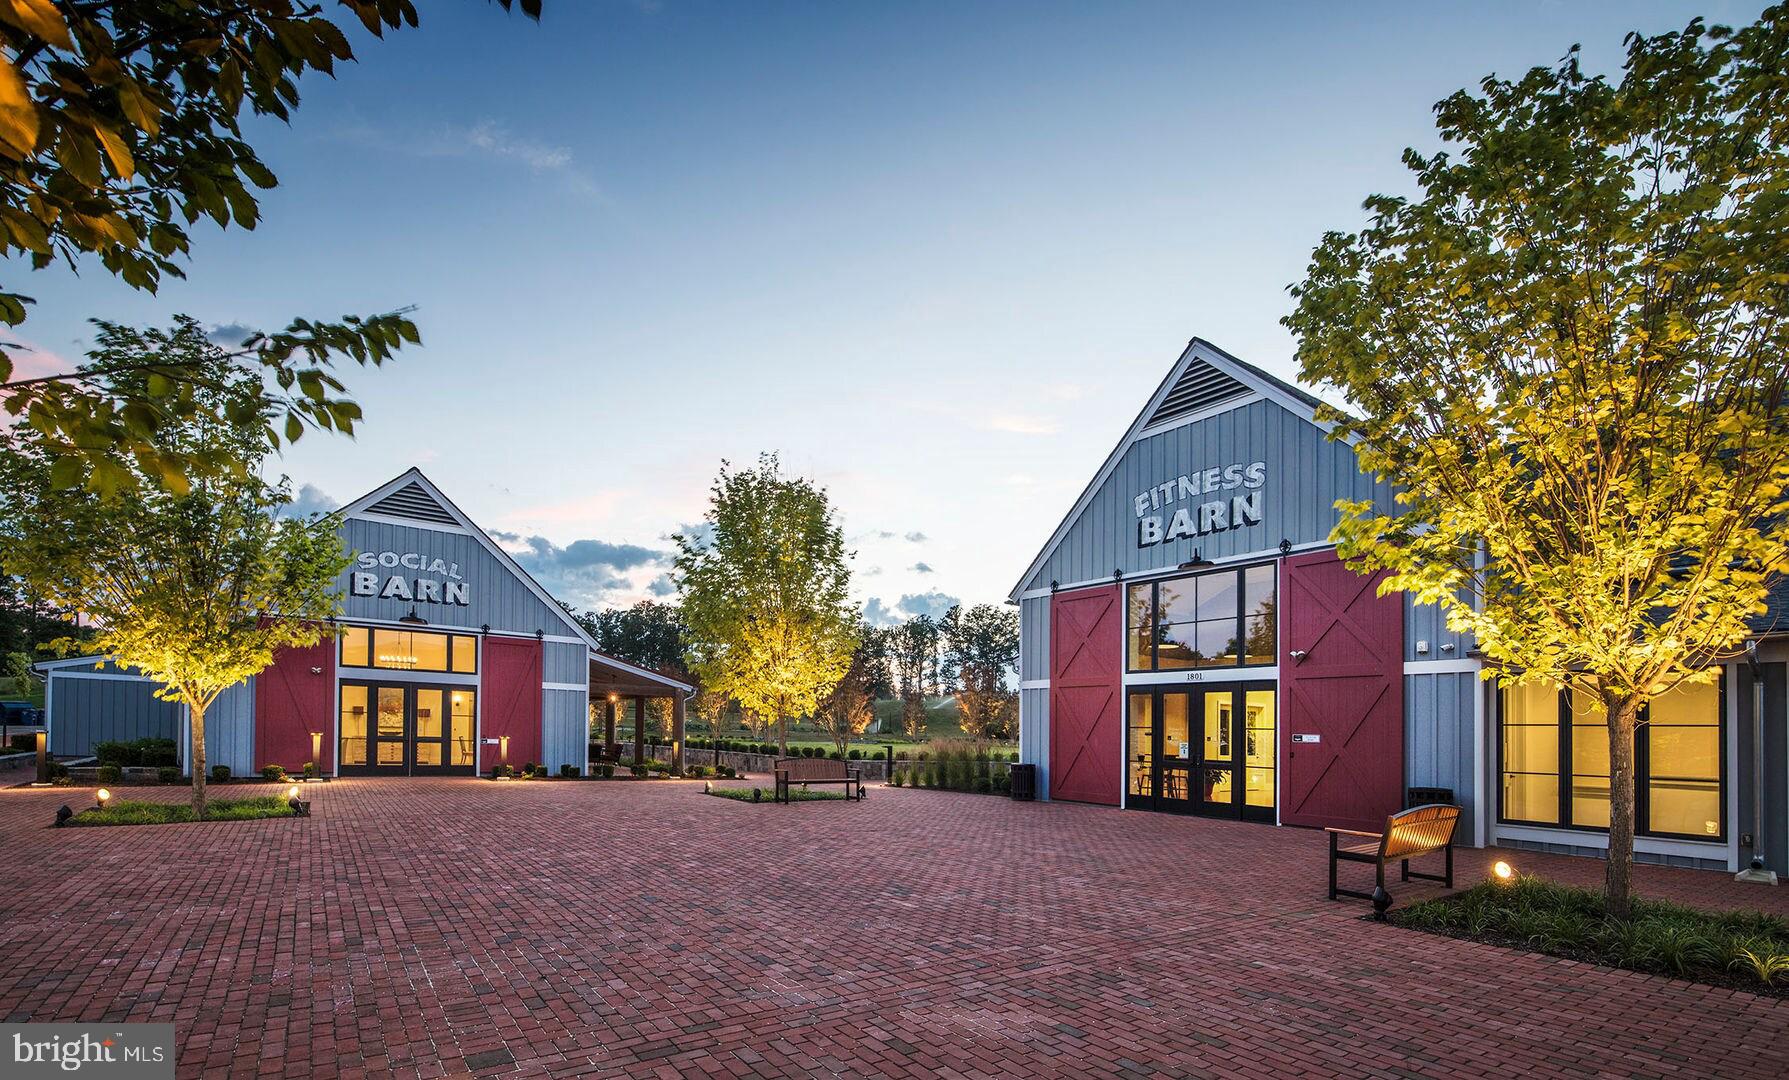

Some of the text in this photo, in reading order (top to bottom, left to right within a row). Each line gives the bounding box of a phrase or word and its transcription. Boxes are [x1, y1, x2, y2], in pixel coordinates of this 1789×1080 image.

[1134, 461, 1266, 518] FITNESS
[1138, 490, 1262, 549] BARN
[357, 551, 463, 580] SOCIAL
[351, 571, 470, 607] BARN
[1186, 672, 1203, 680] 1801
